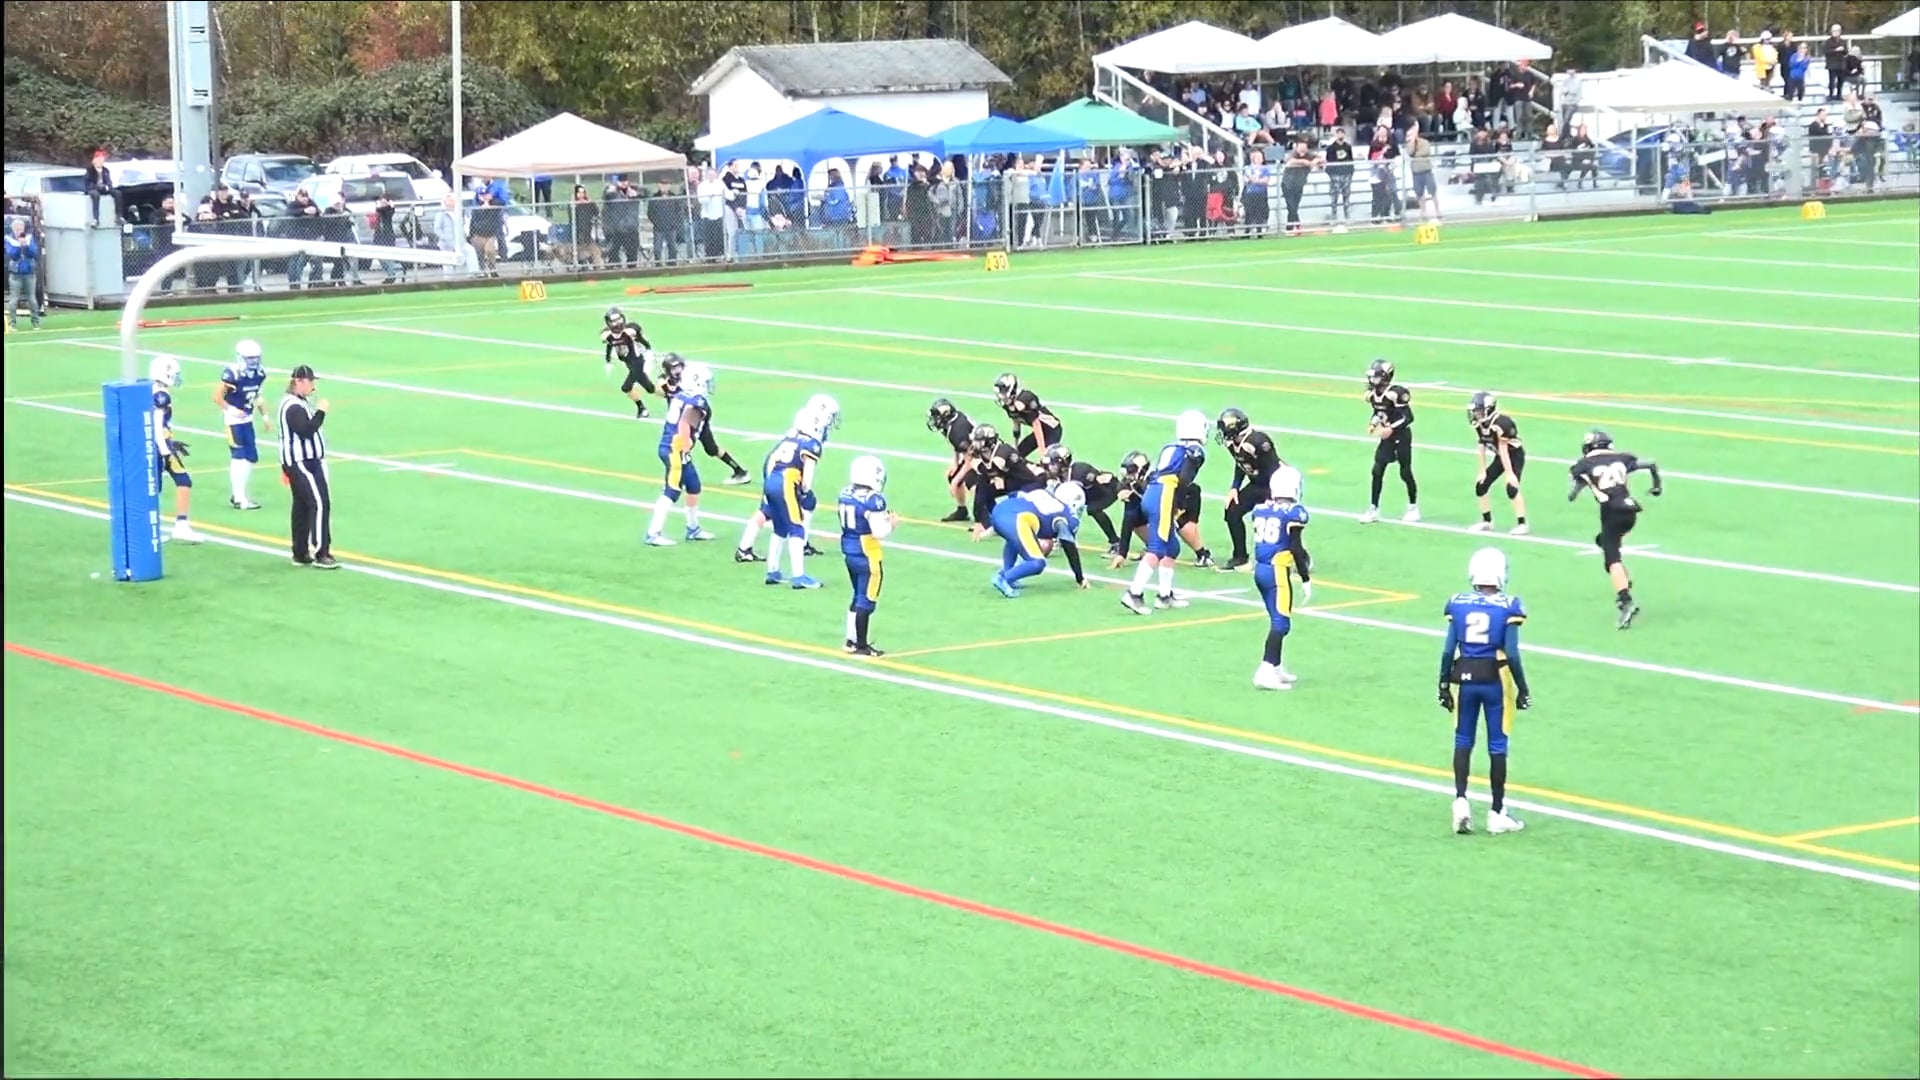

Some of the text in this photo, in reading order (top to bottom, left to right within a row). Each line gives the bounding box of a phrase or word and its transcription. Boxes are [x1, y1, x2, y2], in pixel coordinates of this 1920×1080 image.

[527, 283, 544, 299] 20
[143, 411, 159, 553] HUSTLE HIT
[1593, 462, 1627, 489] 20
[1254, 517, 1281, 544] 36
[1465, 612, 1490, 644] 2
